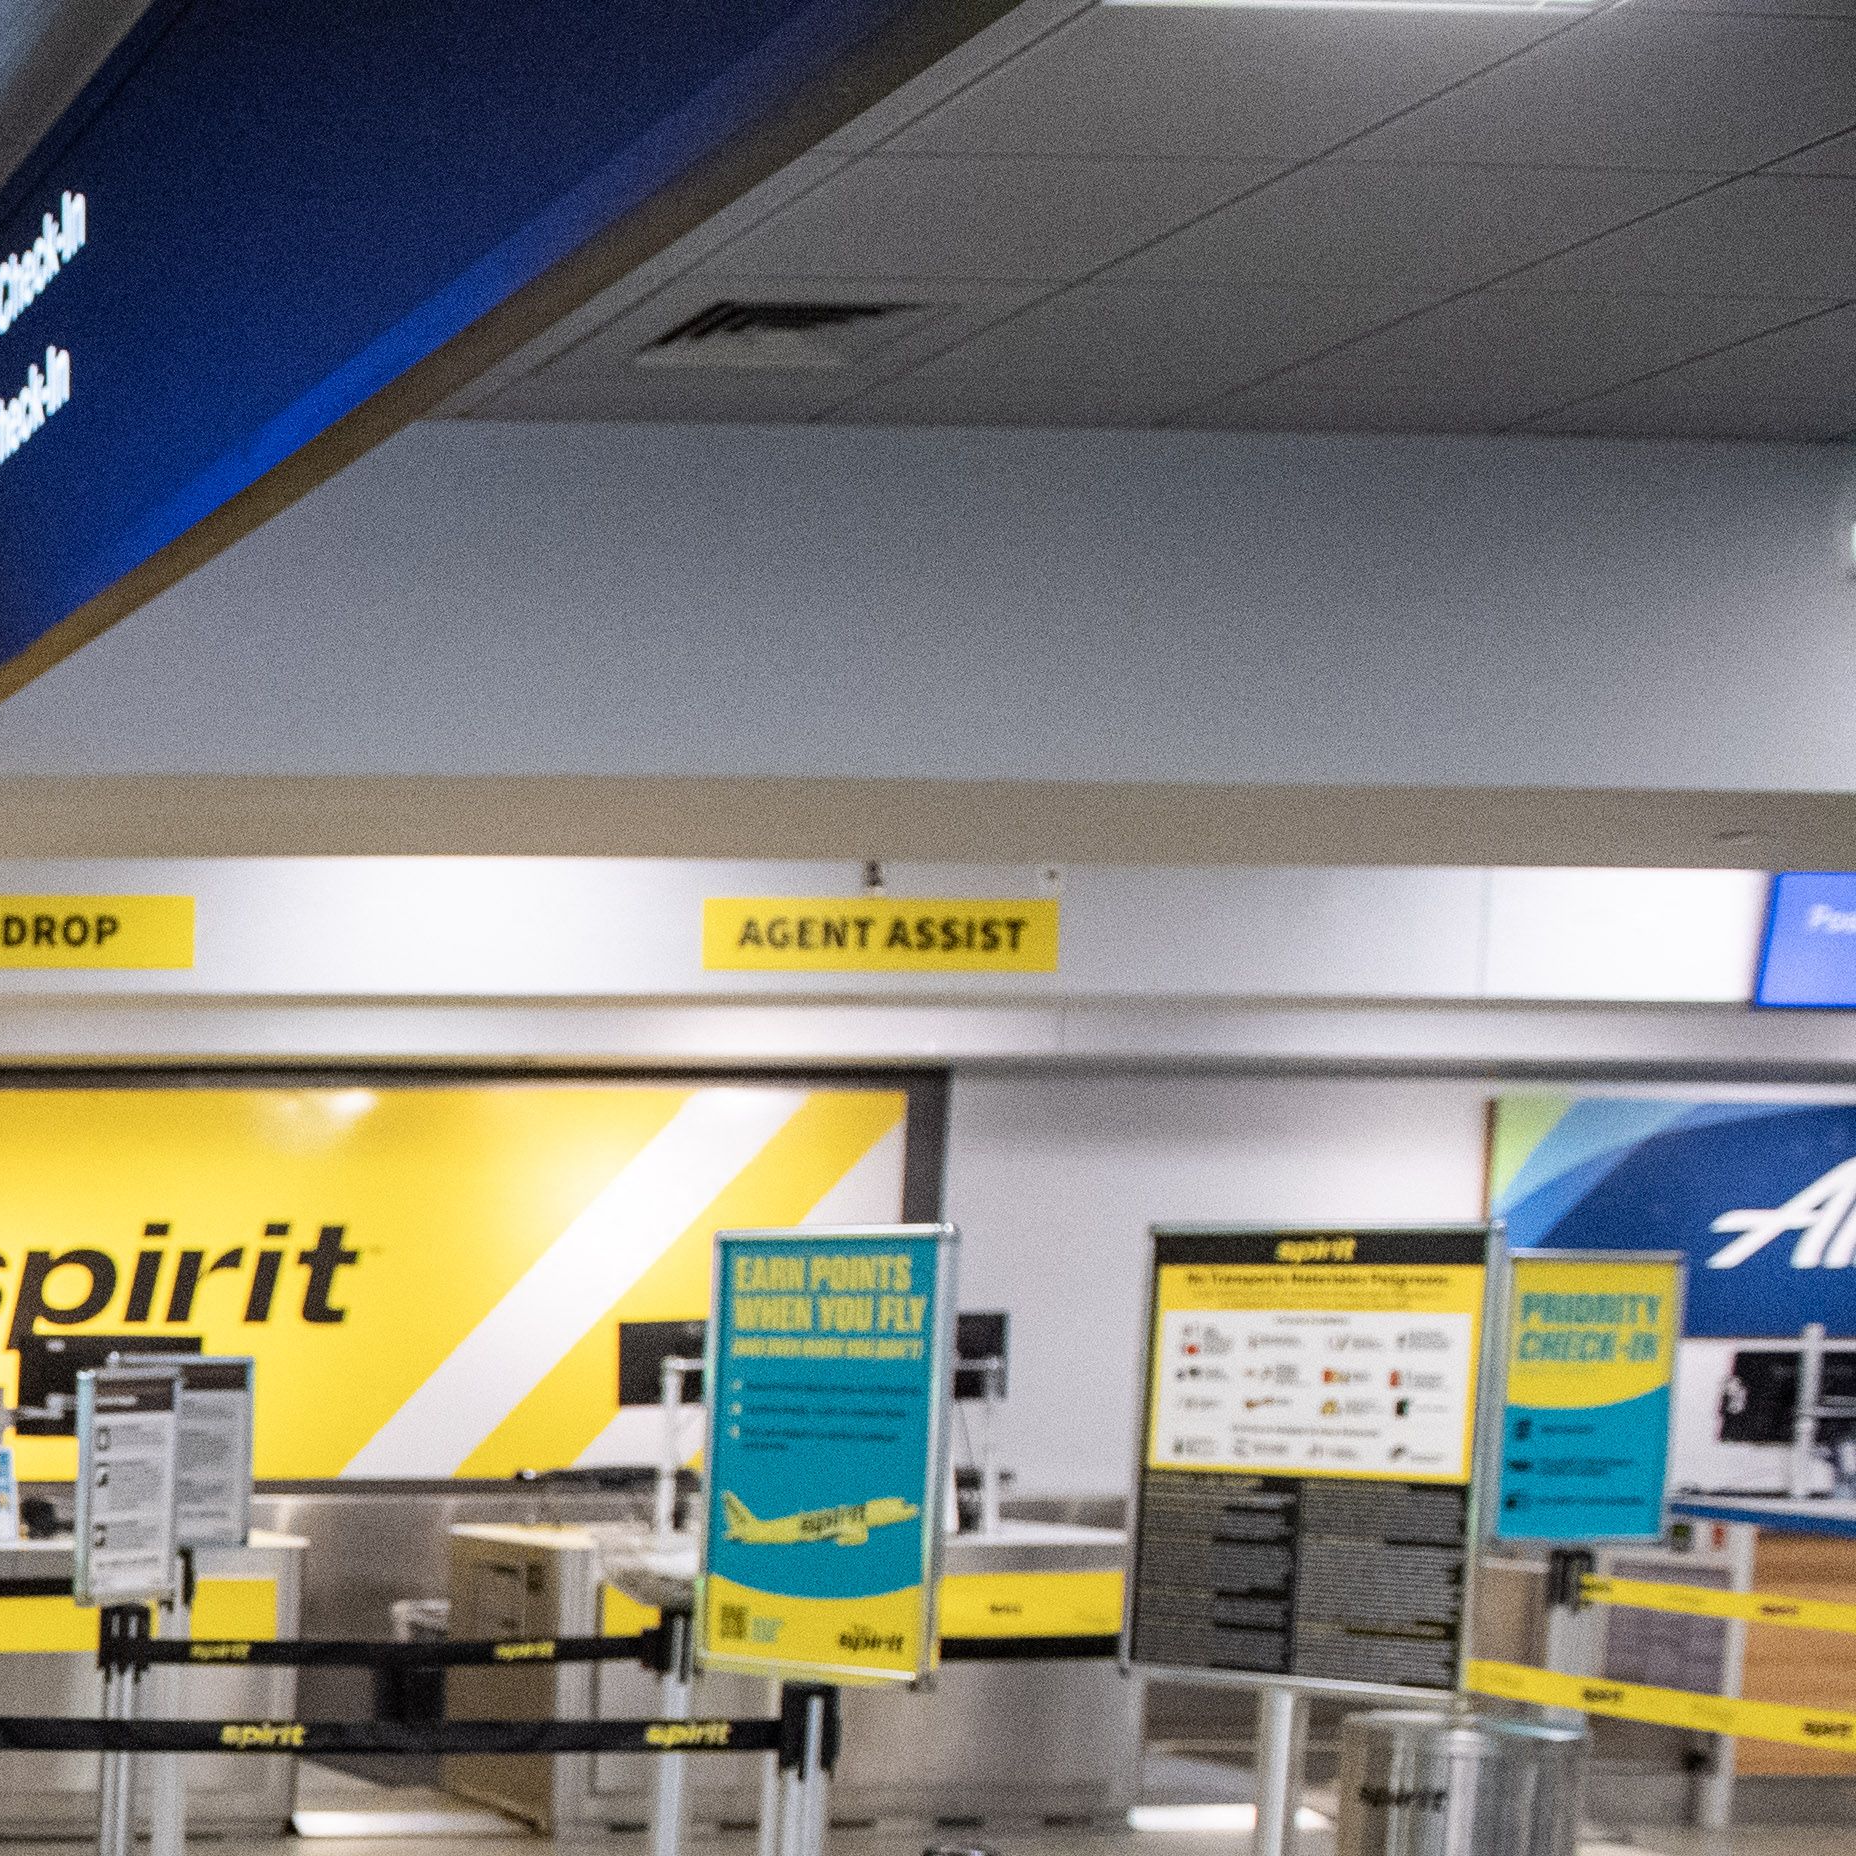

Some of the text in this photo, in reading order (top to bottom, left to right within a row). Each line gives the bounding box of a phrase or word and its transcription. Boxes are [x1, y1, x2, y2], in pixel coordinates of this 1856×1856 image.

[1, 913, 121, 949] DROP
[738, 916, 1029, 952] AGENT ASSIST
[733, 1253, 913, 1292] EARN POINTS
[733, 1295, 928, 1332] WHEN YOU FLY
[1520, 1293, 1661, 1324] PRIORITY
[1518, 1330, 1658, 1361] CHECK-IN
[219, 1723, 307, 1748] spirit
[645, 1721, 732, 1749] spirit
